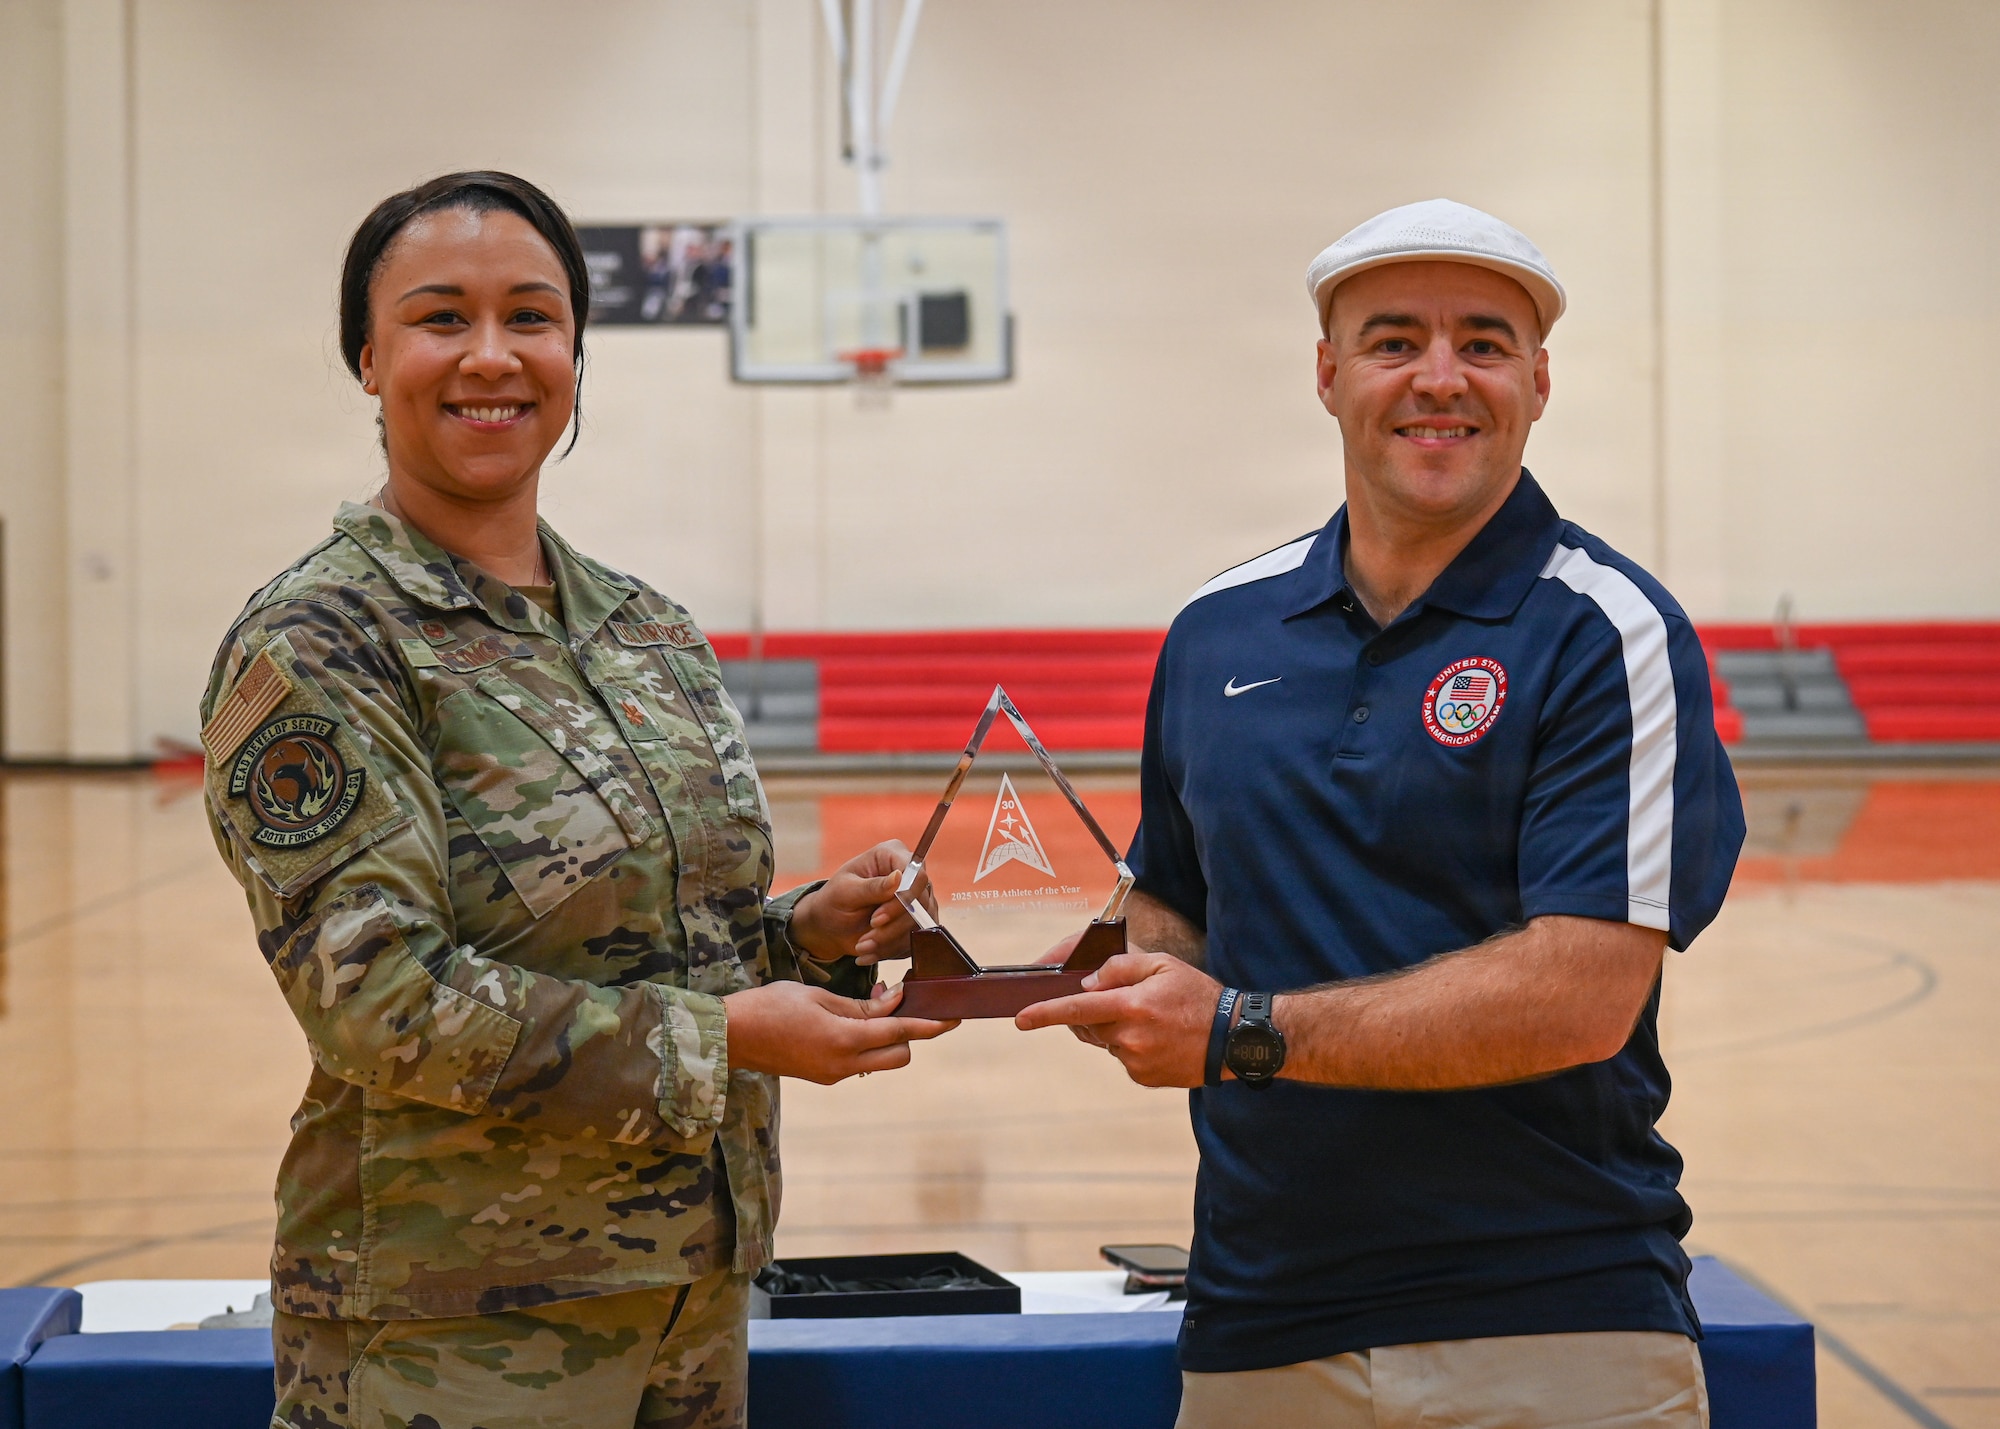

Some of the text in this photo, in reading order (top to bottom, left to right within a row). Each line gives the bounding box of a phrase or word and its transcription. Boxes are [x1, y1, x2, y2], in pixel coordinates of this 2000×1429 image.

[655, 622, 697, 646] FRCE
[1436, 658, 1506, 684] UNITED STATES
[1423, 702, 1501, 745] PAN AMERICAN TEAM
[234, 720, 327, 789] LEAD DEVELOP SERVE
[260, 775, 359, 845] 30TH FORCE SUPPORT SQ
[1001, 800, 1015, 810] 30
[951, 885, 1081, 901] 2025 VSFB Athlete of the Year
